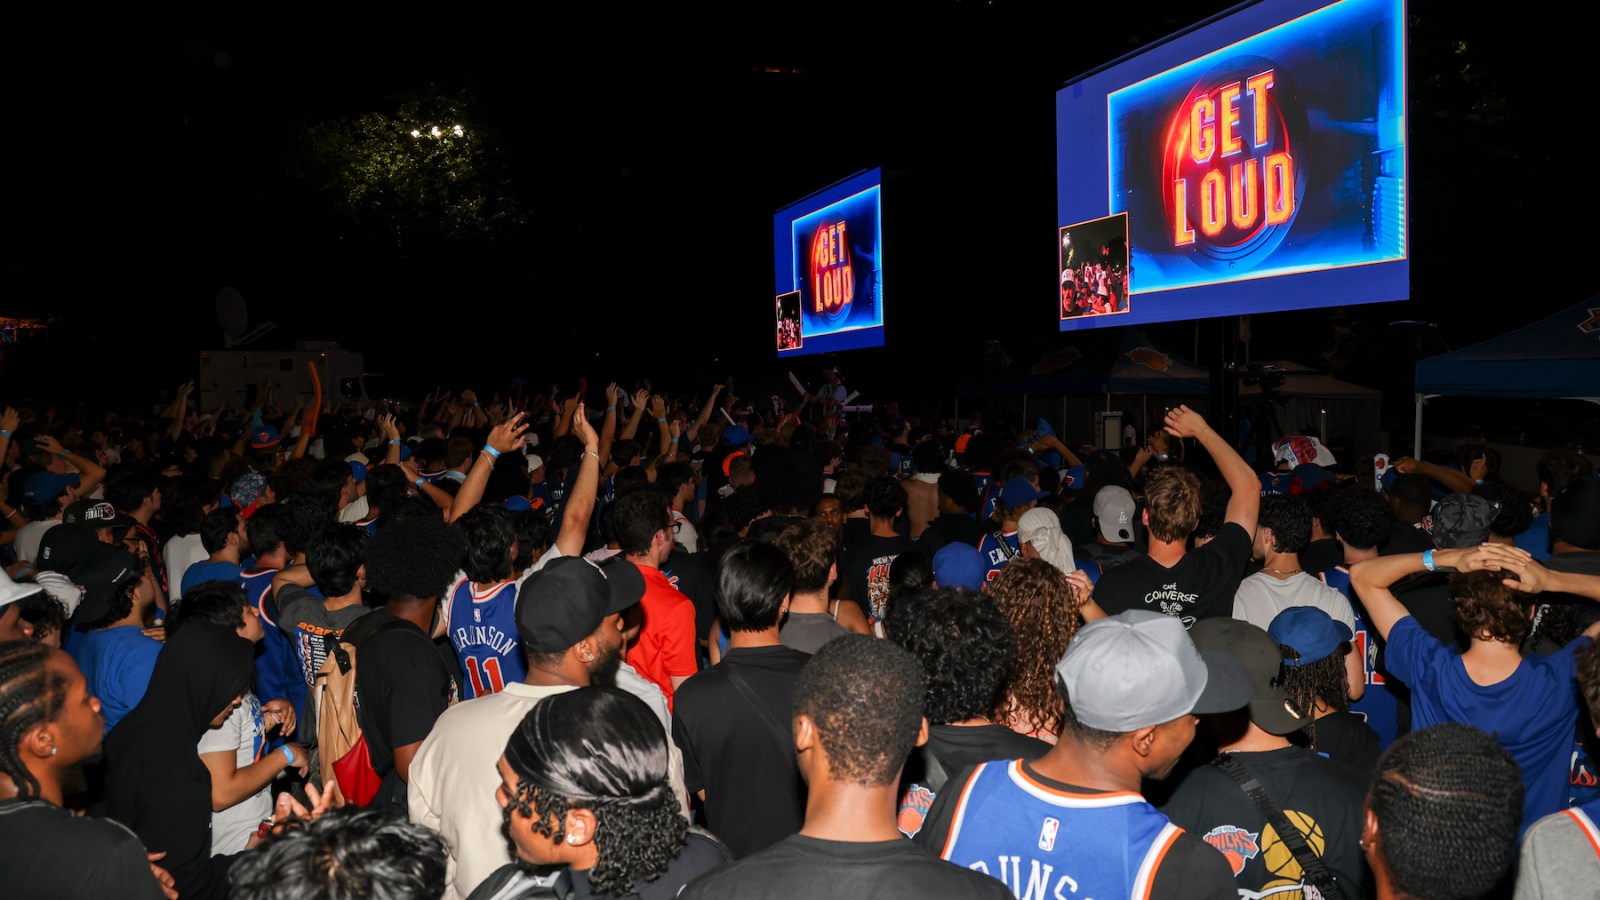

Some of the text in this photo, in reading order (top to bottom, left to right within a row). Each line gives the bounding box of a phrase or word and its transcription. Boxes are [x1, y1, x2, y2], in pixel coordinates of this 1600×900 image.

[1190, 69, 1274, 165] GET
[1174, 152, 1296, 247] LOUD
[820, 220, 847, 268] GET
[815, 265, 853, 313] LOUD
[84, 507, 105, 520] FINALS
[1144, 590, 1200, 604] CONVERSE
[452, 624, 518, 657] BRUNSON
[464, 655, 506, 698] 11
[968, 854, 1093, 900] UNS
